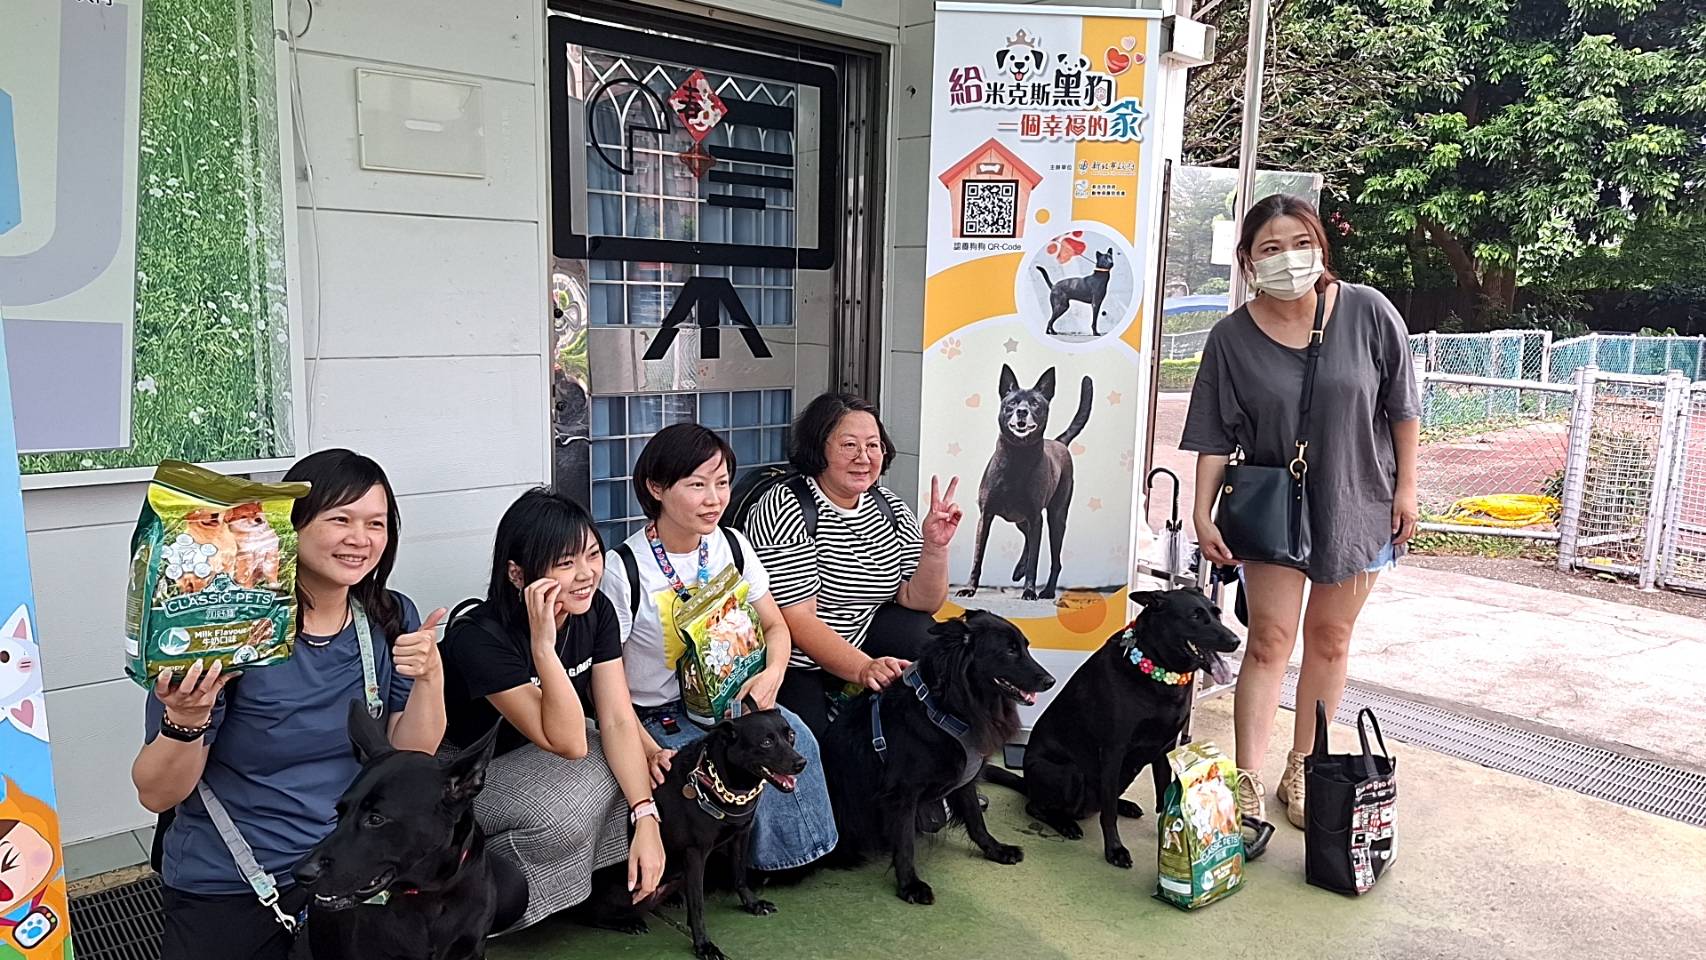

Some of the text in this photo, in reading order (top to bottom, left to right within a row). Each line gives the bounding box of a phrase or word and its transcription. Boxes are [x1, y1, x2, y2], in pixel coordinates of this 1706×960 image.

[949, 66, 1112, 107] 給米克斯黑狗
[998, 100, 1143, 138] 一個幸福的家
[987, 242, 1022, 251] QR-Code
[168, 592, 271, 612] CLASSIC PETS
[195, 631, 213, 639] Milk
[158, 664, 185, 672] Pppy
